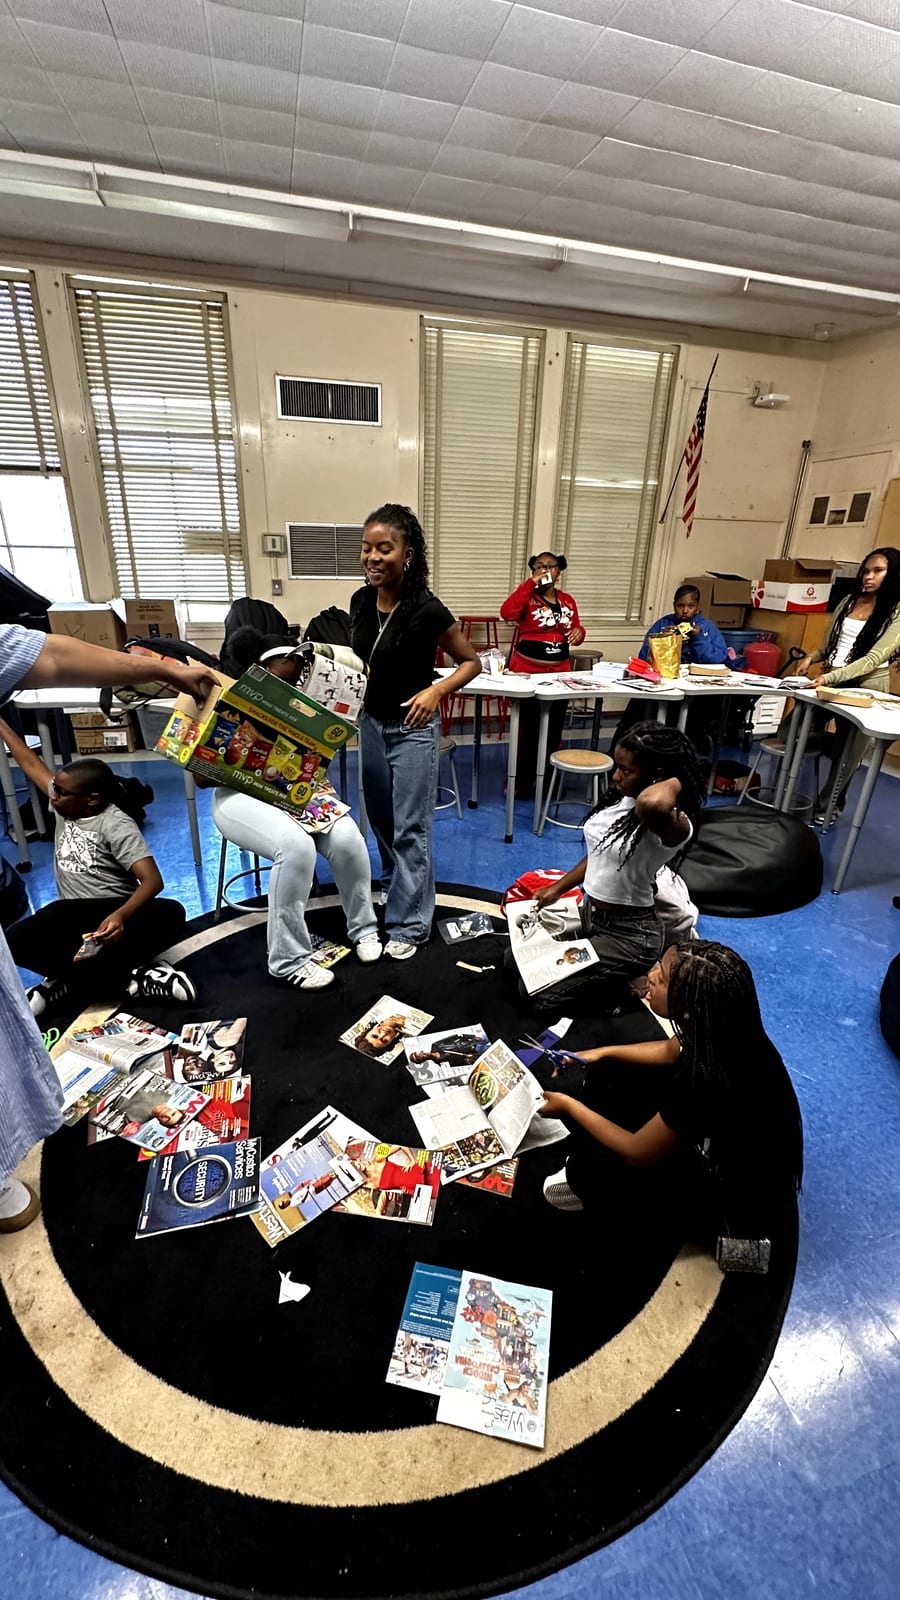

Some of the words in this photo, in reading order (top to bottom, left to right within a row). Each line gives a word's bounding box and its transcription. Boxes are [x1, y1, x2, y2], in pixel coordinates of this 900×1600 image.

[238, 683, 265, 702] mvp
[232, 769, 254, 784] mvp
[296, 785, 308, 797] 60
[234, 1141, 246, 1179] Services
[194, 1161, 207, 1202] SECURITY
[454, 1355, 500, 1374] CALIFORNIA
[463, 1367, 492, 1382] HIDDEN
